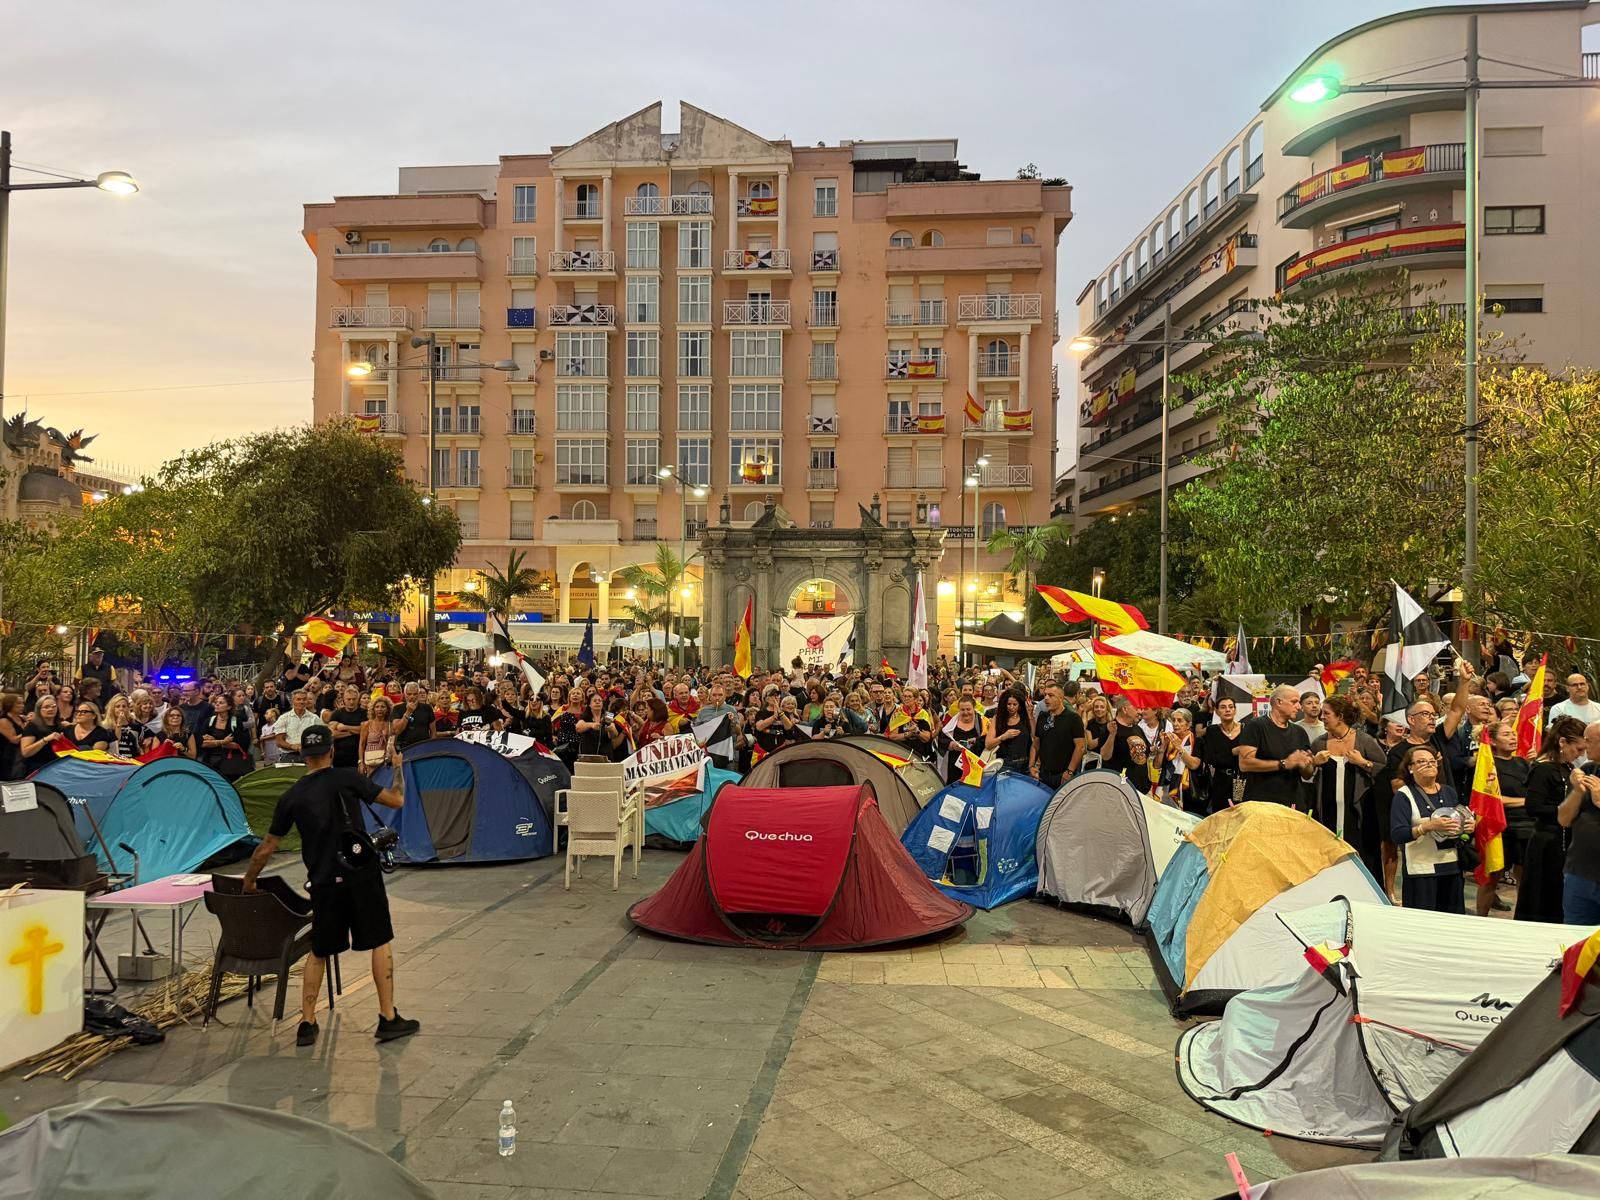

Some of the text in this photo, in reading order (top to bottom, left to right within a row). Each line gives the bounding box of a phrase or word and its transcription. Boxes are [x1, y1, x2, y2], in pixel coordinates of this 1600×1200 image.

[799, 647, 824, 656] PARA
[808, 655, 823, 663] MI
[745, 830, 813, 842] Quechua
[1455, 1010, 1504, 1025] Quec
